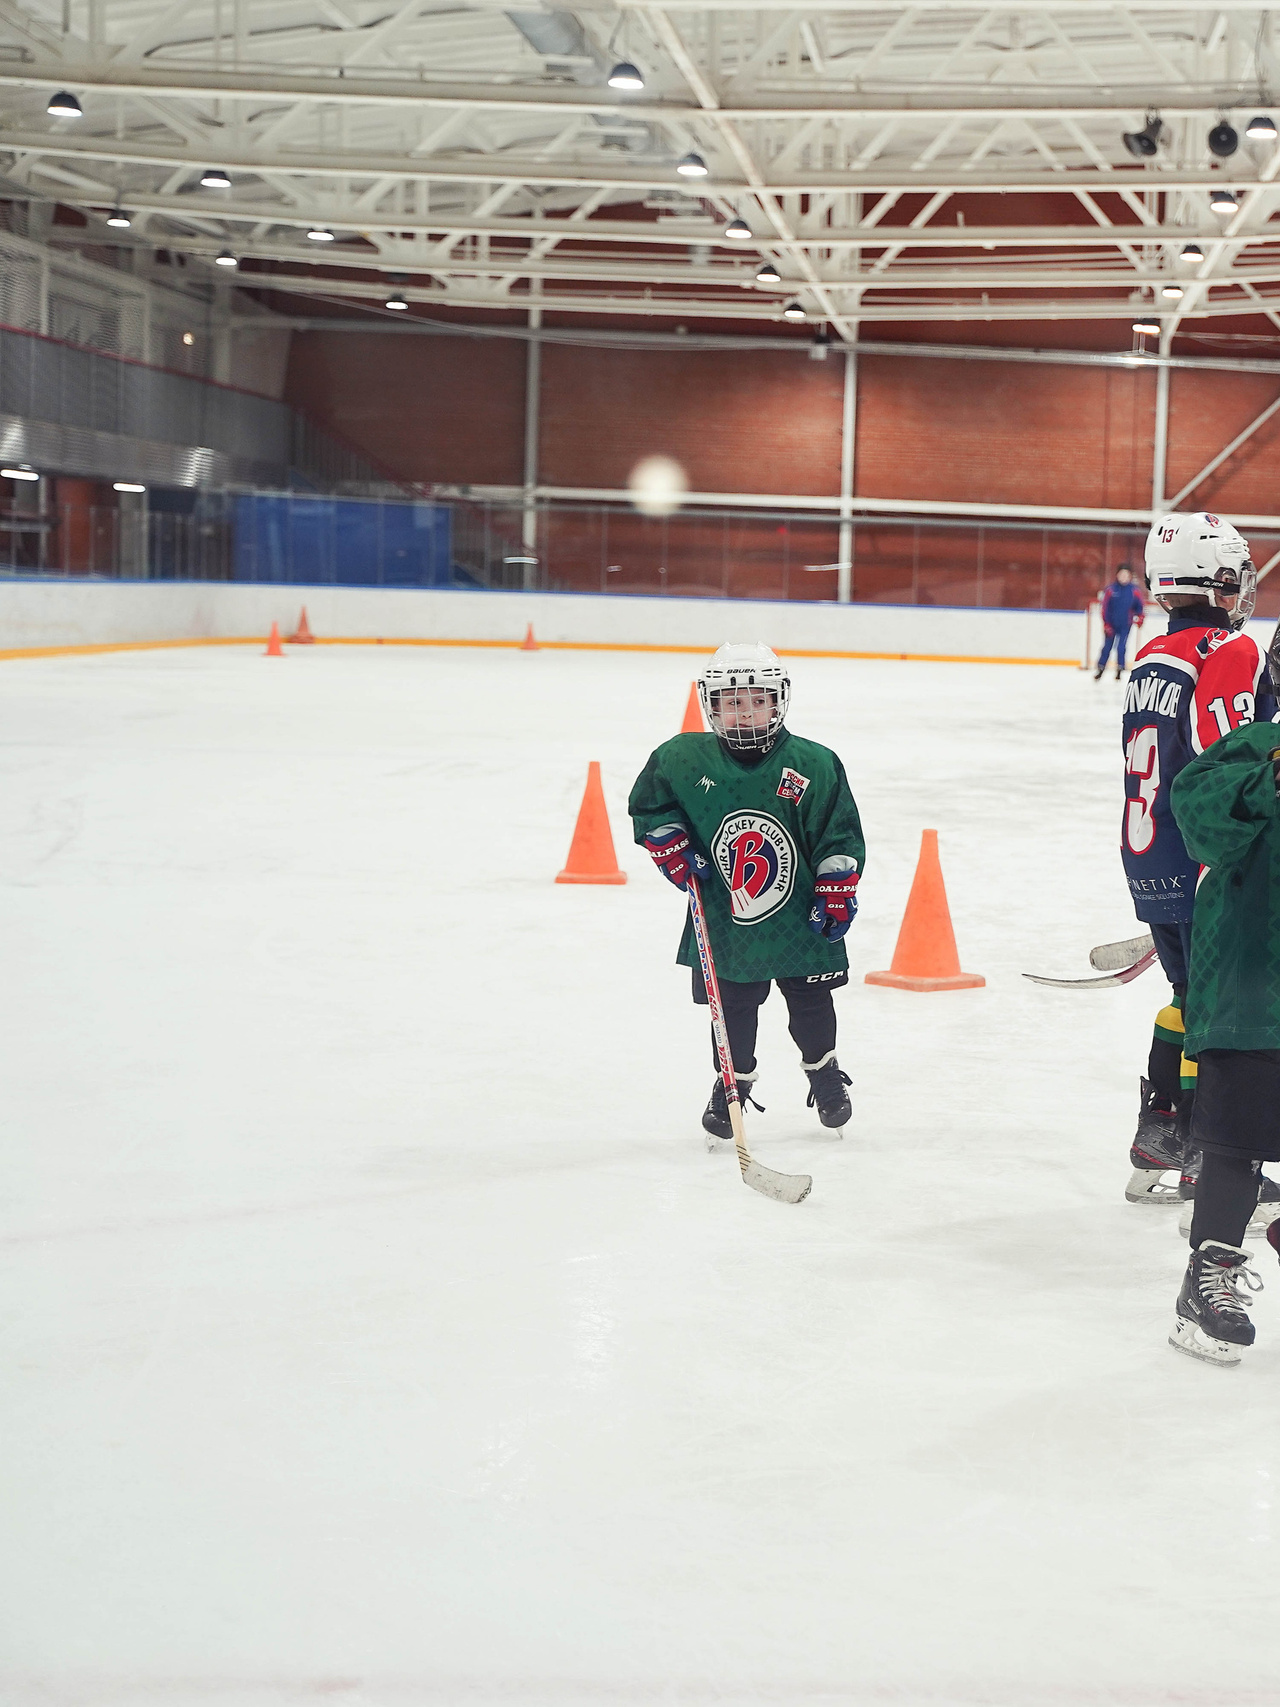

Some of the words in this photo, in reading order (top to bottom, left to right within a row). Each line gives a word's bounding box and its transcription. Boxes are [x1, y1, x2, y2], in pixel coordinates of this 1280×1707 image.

[1161, 529, 1175, 543] 13
[1208, 691, 1256, 738] 13
[758, 822, 784, 847] CLUB
[773, 851, 790, 893] VIKHR
[806, 970, 844, 983] CCM
